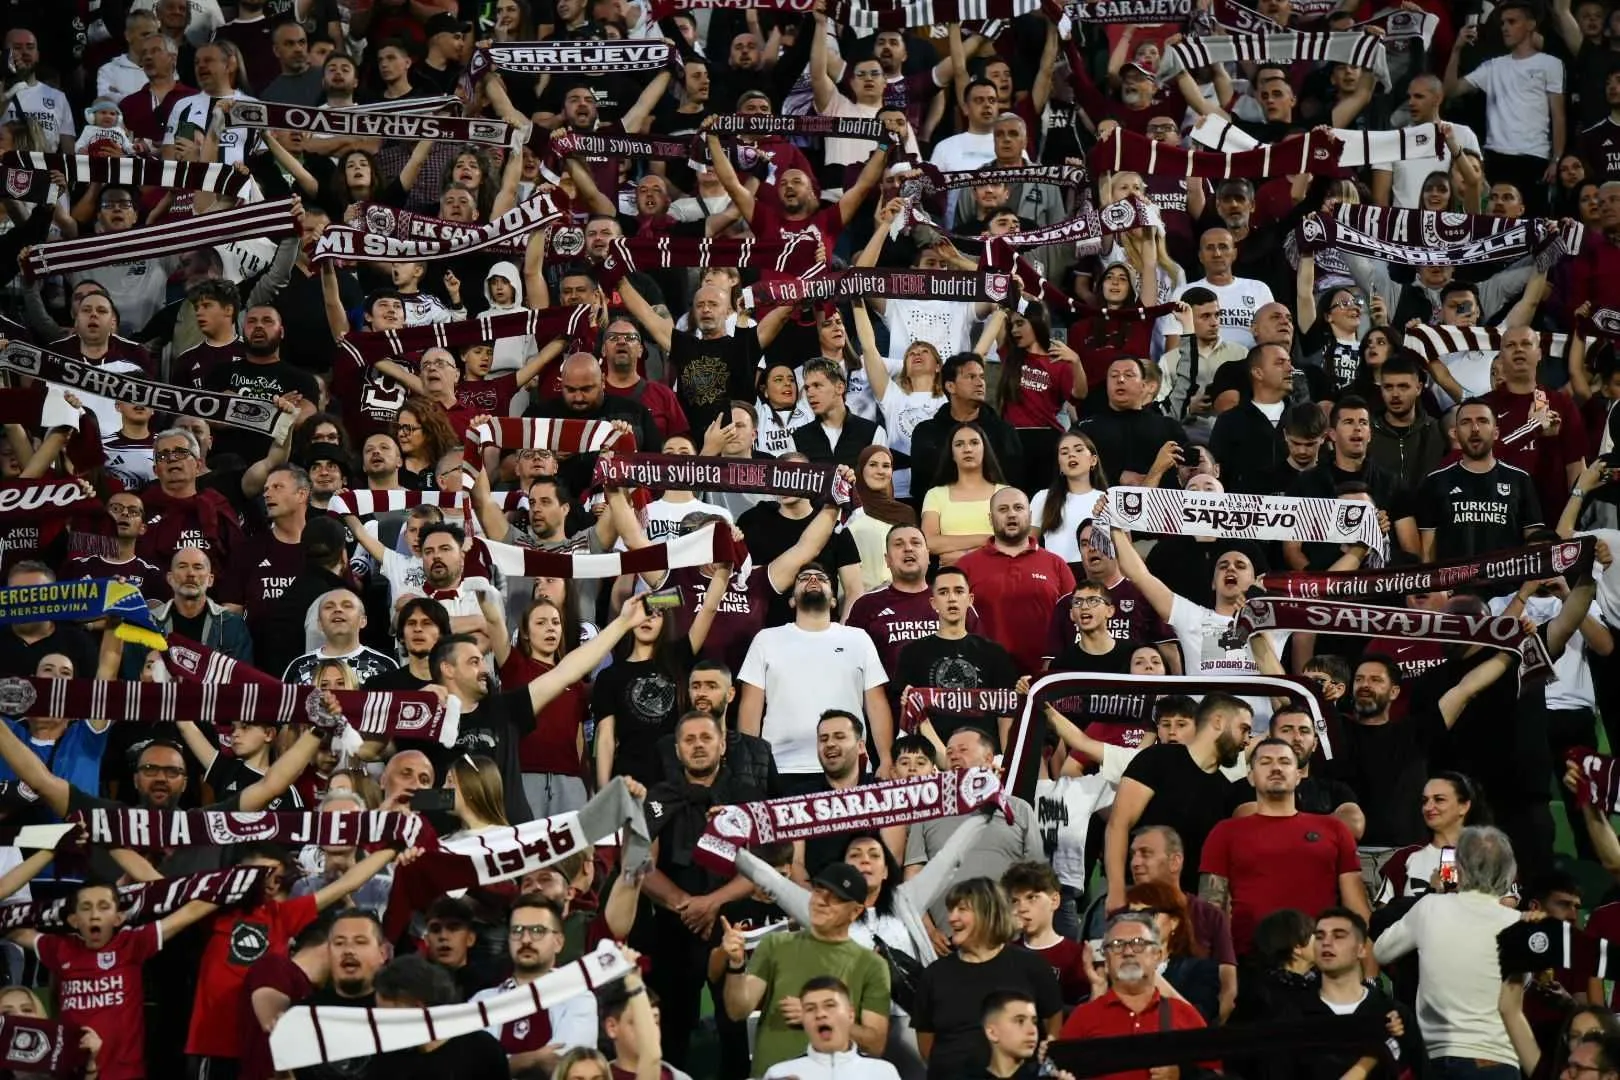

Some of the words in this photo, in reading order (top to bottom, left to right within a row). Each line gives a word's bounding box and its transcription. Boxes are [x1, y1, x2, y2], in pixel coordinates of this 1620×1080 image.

[1096, 0, 1191, 17] SARAJEVO
[488, 45, 670, 65] SARAJEVO
[285, 108, 440, 138] SARAJEVO
[751, 115, 795, 132] svijeta
[838, 117, 882, 136] bodriti
[315, 231, 354, 254] MI
[802, 279, 836, 299] kraju
[840, 274, 885, 297] svijeta
[932, 277, 977, 297] bodriti
[62, 362, 220, 417] SARAJEVO
[667, 462, 721, 486] svijeta
[728, 463, 768, 487] TEBE
[773, 466, 825, 493] bodriti
[0, 483, 86, 512] evo
[1265, 503, 1298, 511] KLUB
[1452, 502, 1508, 513] TURKISH
[1183, 507, 1295, 531] SARAJEVO
[1453, 512, 1507, 525] AIRLINES
[0, 582, 98, 605] ERCEGOVINA
[1375, 572, 1431, 595] svijeta
[11, 602, 88, 617] HERZEGOVINA
[1306, 606, 1520, 640] SARAJEVO
[930, 688, 972, 712] kraju
[813, 781, 938, 821] SARAJEVO
[814, 825, 831, 835] IGRA
[885, 815, 894, 823] ZA
[931, 807, 941, 816] JA
